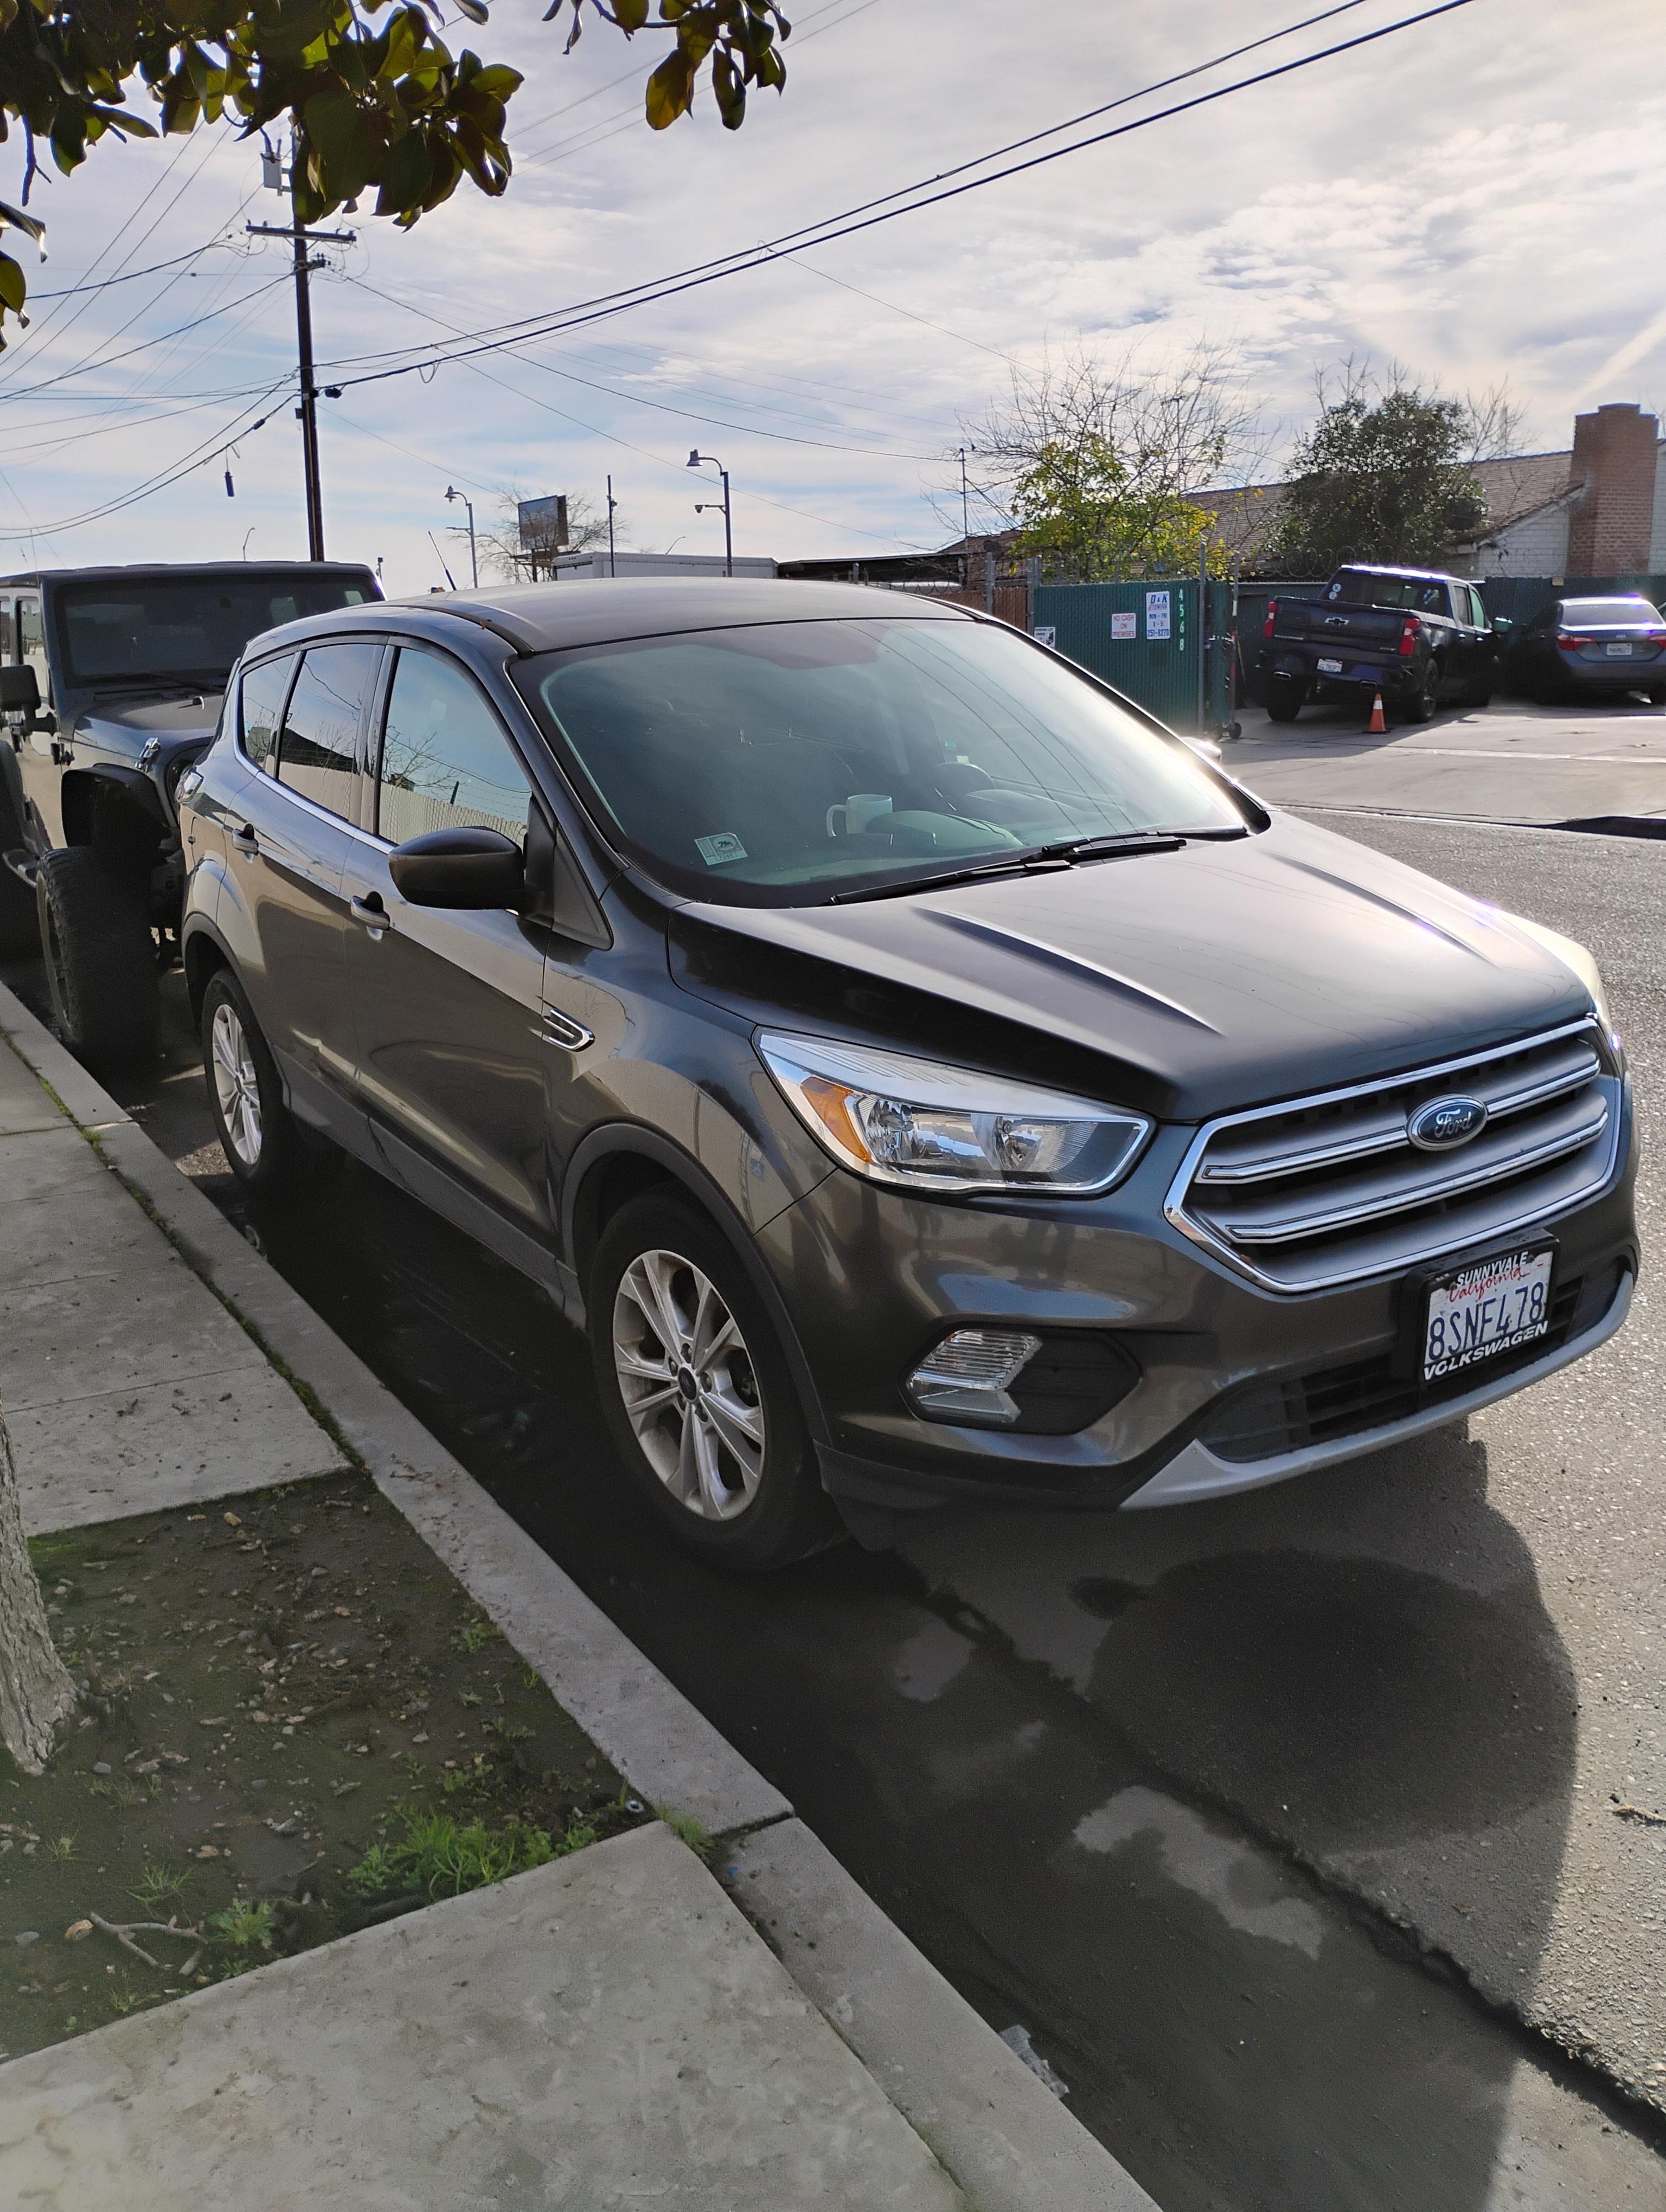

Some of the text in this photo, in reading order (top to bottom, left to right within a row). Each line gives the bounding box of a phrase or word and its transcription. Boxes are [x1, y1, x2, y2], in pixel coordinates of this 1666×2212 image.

[1151, 595, 1156, 604] D
[1434, 1109, 1472, 1138] Ford
[1457, 1251, 1529, 1287] SUNNYVALE
[1428, 1281, 1545, 1361] 8SNF478
[1424, 1320, 1548, 1381] VOLKSWAGEN
